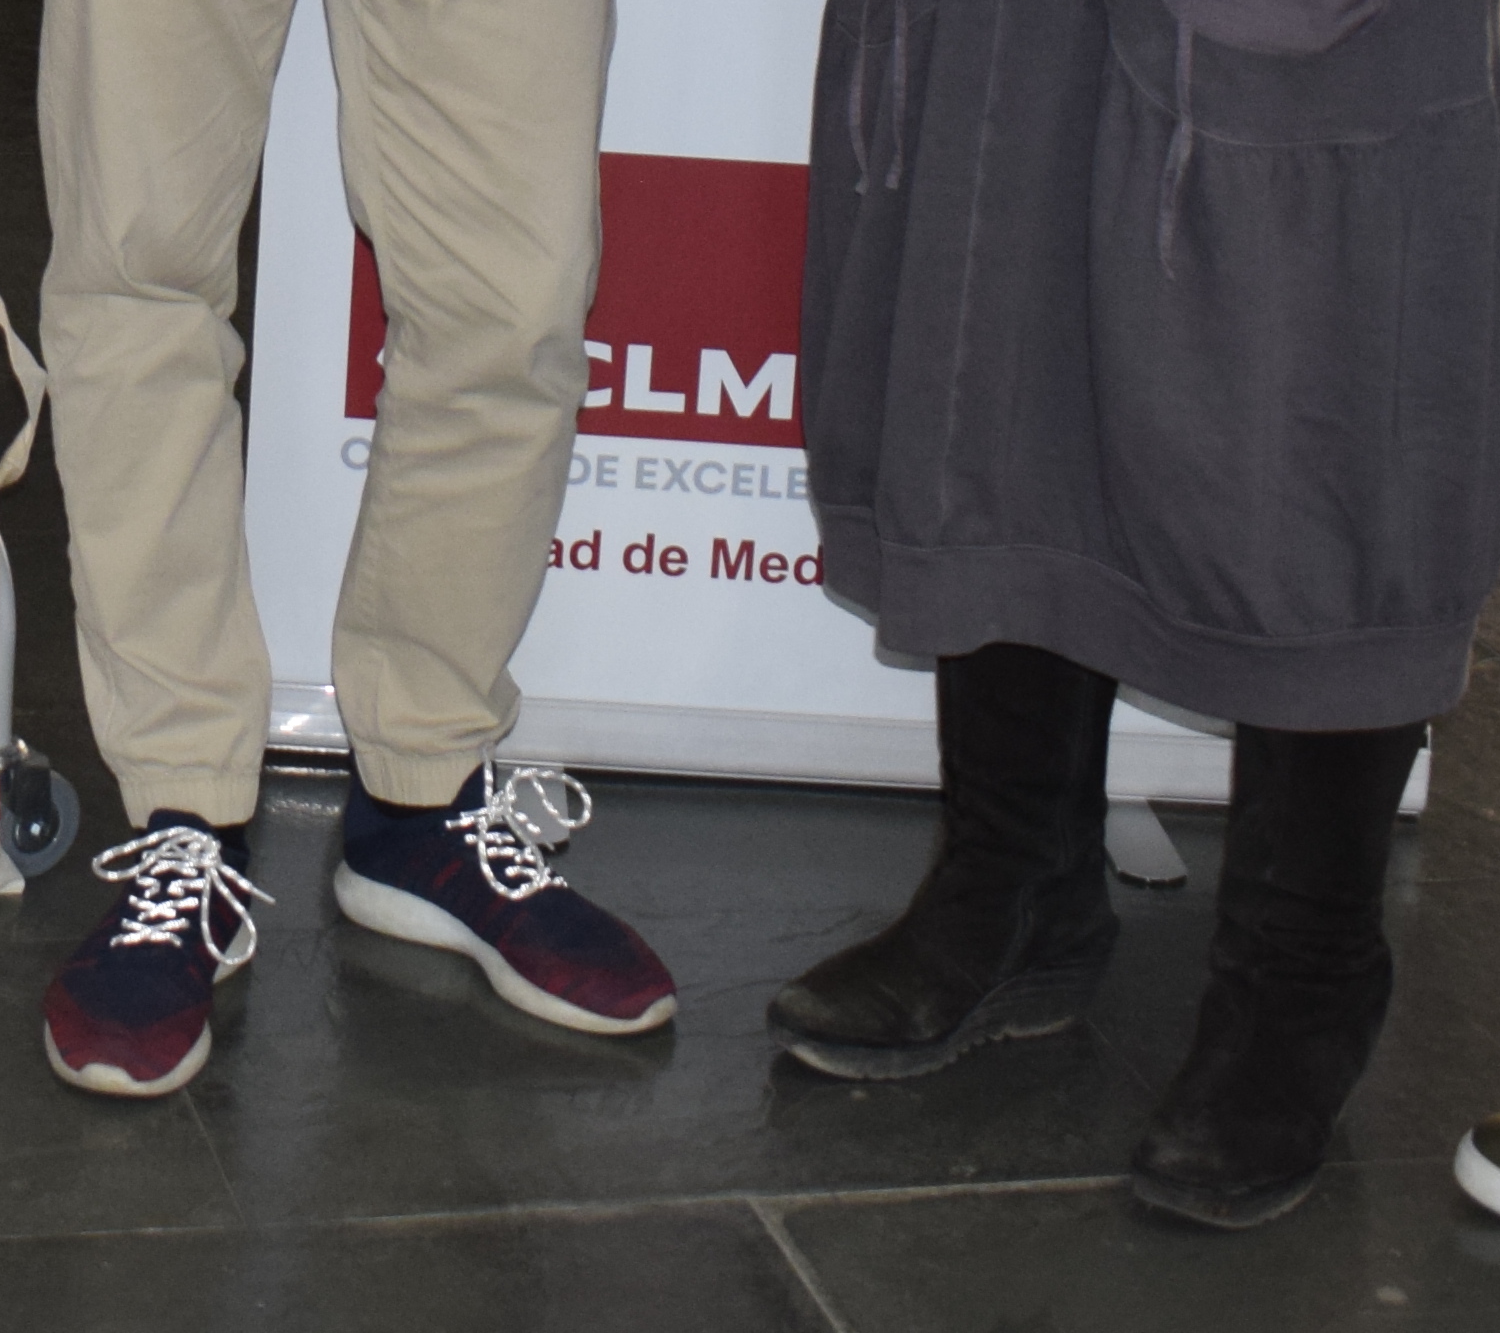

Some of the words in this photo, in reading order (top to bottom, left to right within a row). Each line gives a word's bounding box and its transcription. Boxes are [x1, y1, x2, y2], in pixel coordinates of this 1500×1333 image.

[567, 455, 619, 489] DE
[635, 458, 812, 502] EXCELE
[622, 533, 690, 577] de
[710, 538, 826, 586] Med
